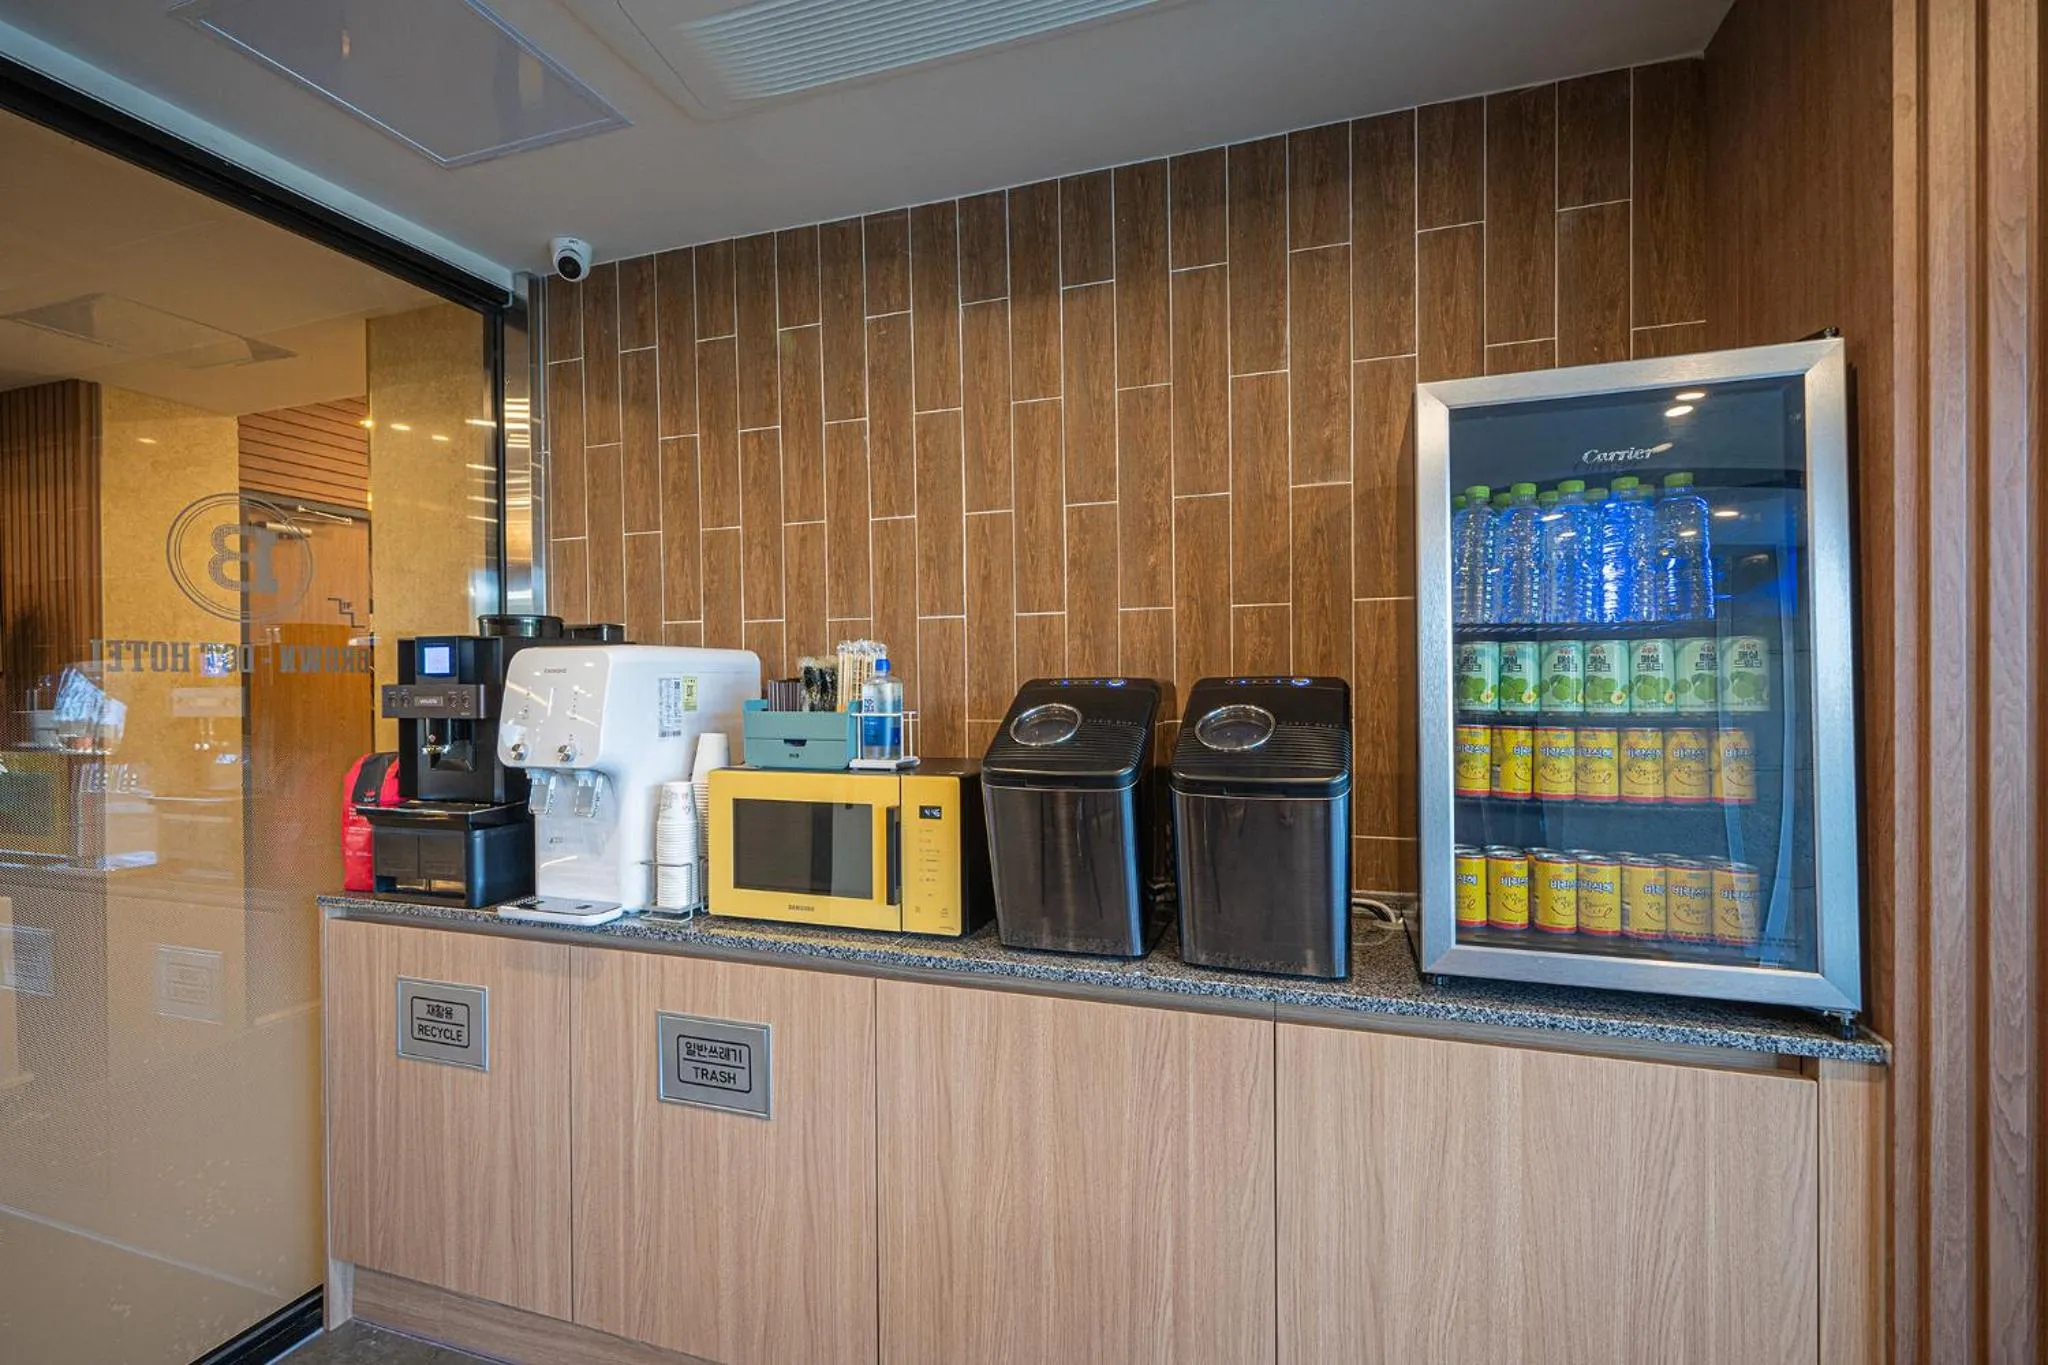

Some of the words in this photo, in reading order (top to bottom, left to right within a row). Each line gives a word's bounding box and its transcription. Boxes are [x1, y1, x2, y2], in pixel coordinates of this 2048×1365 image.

[1582, 447, 1652, 465] Carrier
[425, 1003, 454, 1020] 재활용
[416, 1023, 464, 1042] RECYCLE
[684, 1041, 743, 1063] 일반쓰레기
[691, 1066, 737, 1085] TRASH
